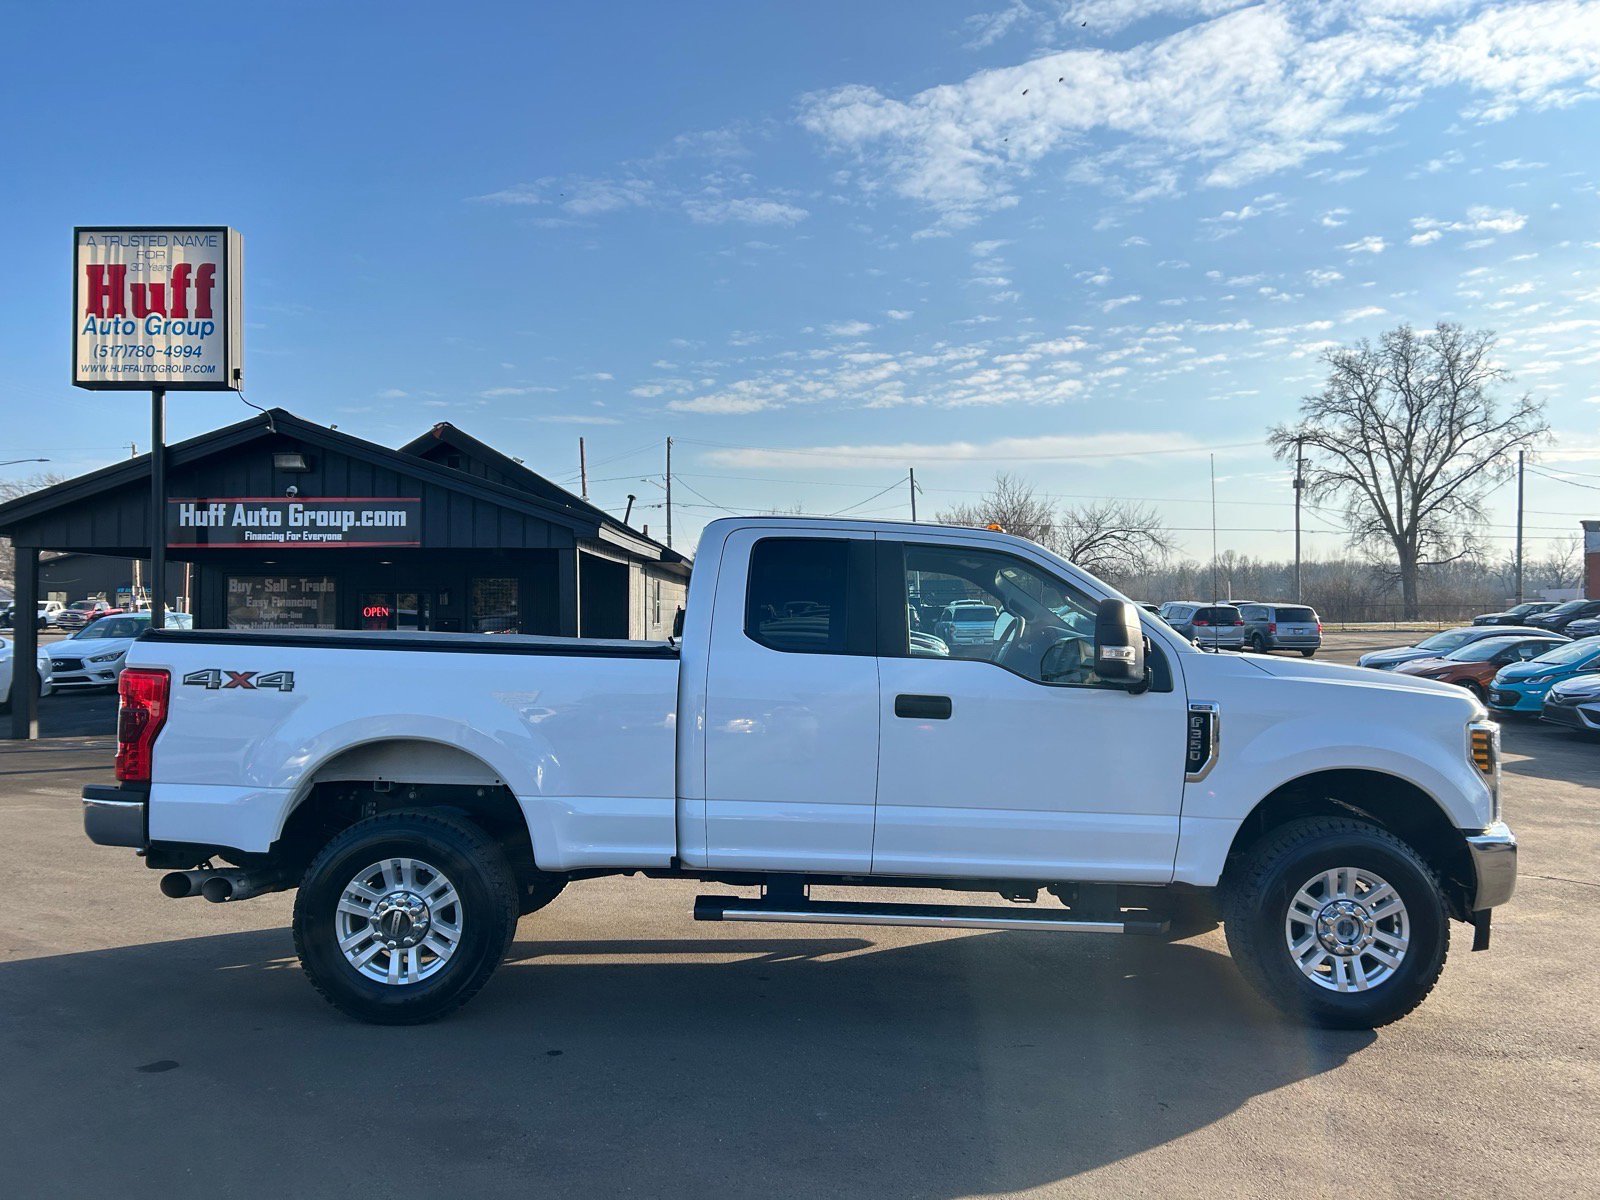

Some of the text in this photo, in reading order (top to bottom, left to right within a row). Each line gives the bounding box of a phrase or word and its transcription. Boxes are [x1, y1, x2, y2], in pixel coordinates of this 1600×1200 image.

[86, 235, 217, 247] A TRUSTED NAME
[136, 250, 165, 260] FOR
[130, 263, 172, 272] 30 Years
[85, 263, 216, 319] Huff
[82, 315, 215, 340] Auto Group
[93, 344, 203, 359] (517)780-4994
[81, 364, 216, 374] WWW.HUFFAUTOGROUP.COM
[179, 503, 407, 531] Huff Auto Group.com
[244, 531, 342, 543] Financing For Everyone
[228, 578, 252, 594] Buy
[264, 578, 288, 592] Sell
[299, 578, 335, 592] Trade
[246, 596, 318, 609] Easy Financing
[259, 611, 278, 621] Apply
[363, 606, 389, 618] OPEN
[228, 621, 335, 630] wwwHuffAutoGroupcom
